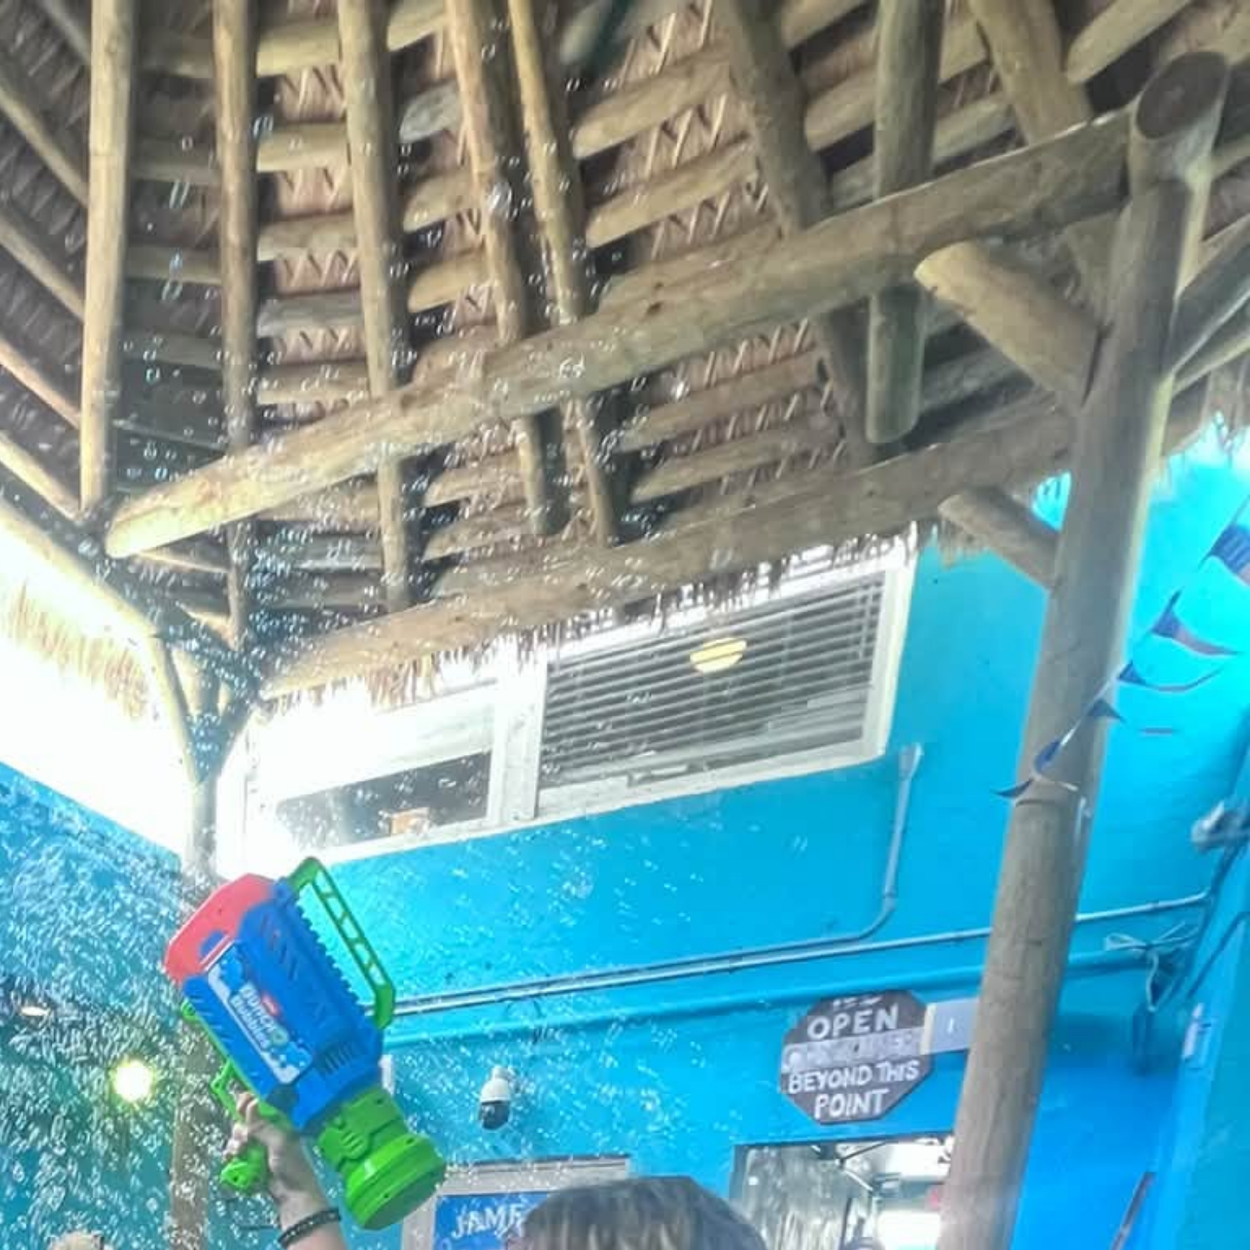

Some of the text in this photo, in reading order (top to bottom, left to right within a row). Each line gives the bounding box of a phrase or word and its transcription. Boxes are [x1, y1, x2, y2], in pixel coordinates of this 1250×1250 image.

[807, 1002, 899, 1040] OPEN
[788, 1059, 920, 1094] BEYOND THIS
[814, 1088, 889, 1119] POINT
